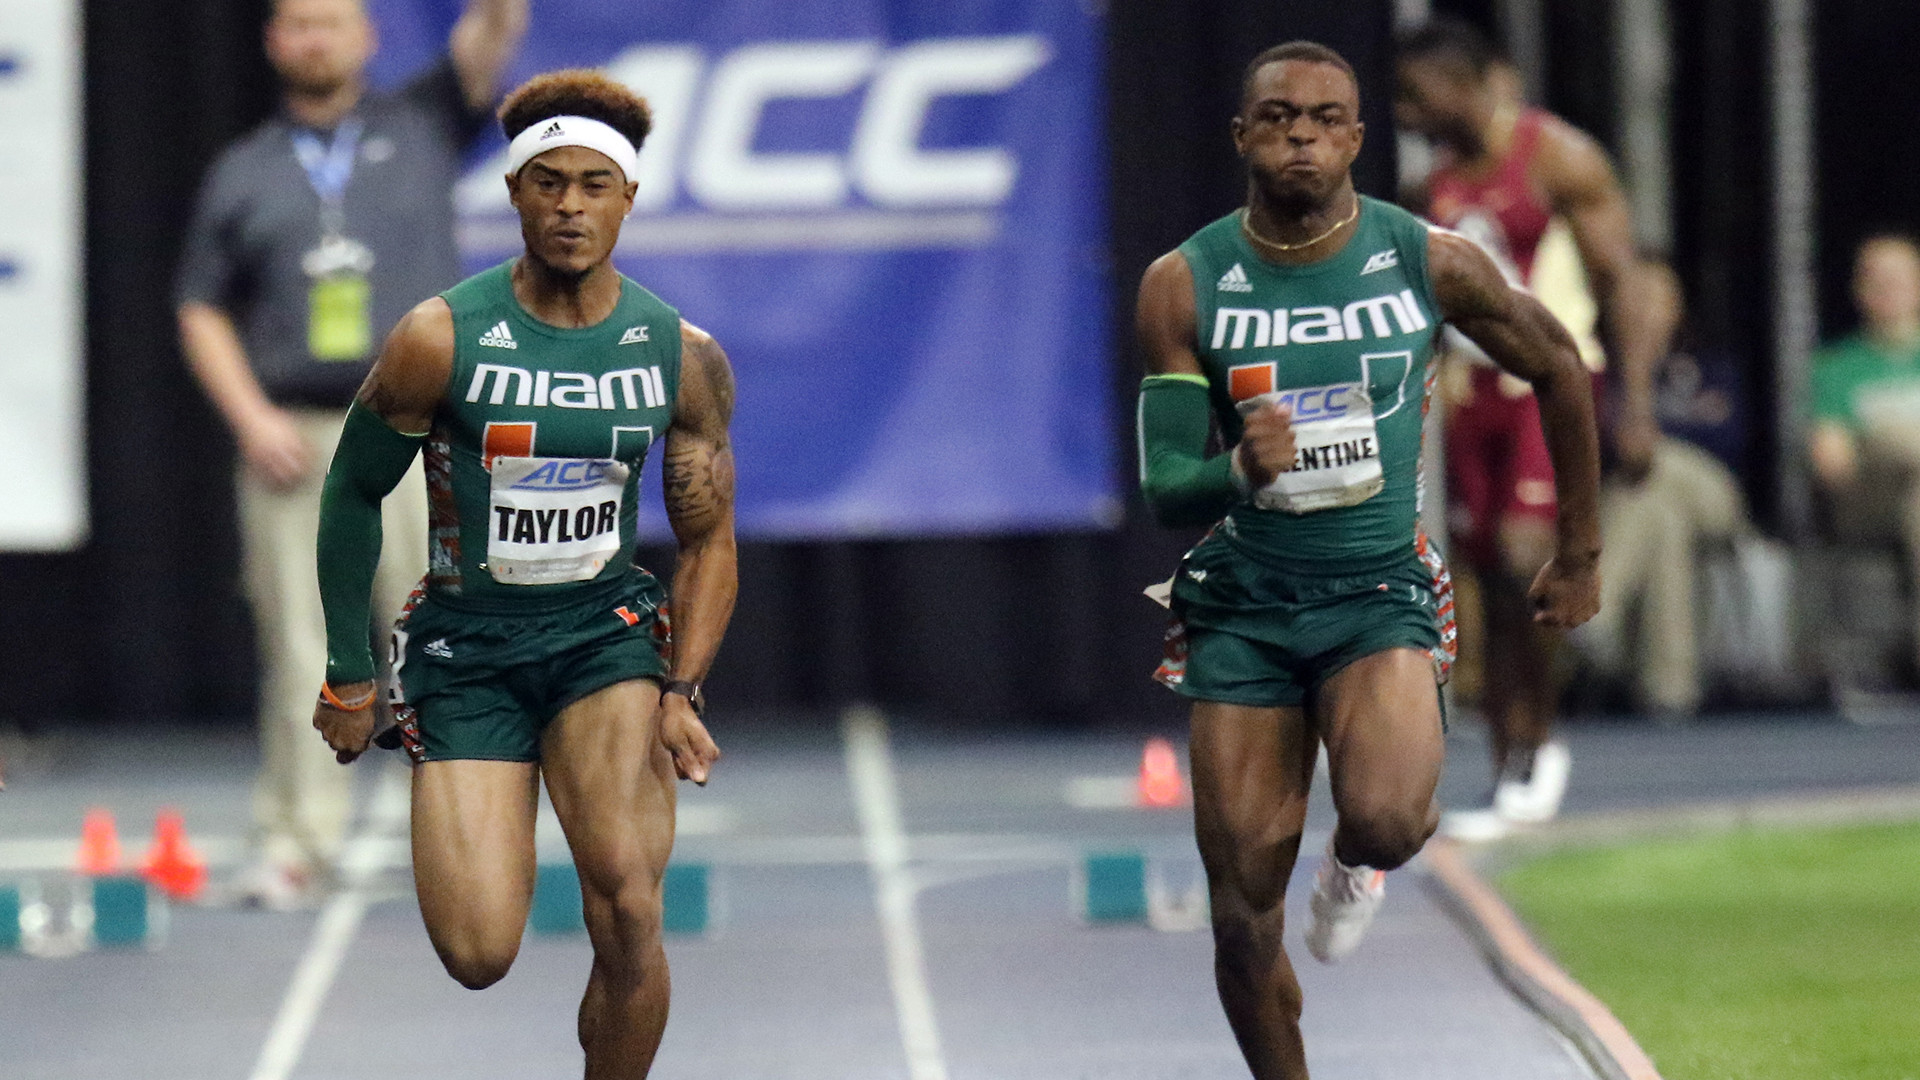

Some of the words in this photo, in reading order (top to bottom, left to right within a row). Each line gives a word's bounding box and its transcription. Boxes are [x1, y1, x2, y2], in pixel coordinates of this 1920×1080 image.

[479, 337, 517, 349] adidas
[518, 461, 613, 485] ACC
[494, 501, 616, 544] TAYLOR
